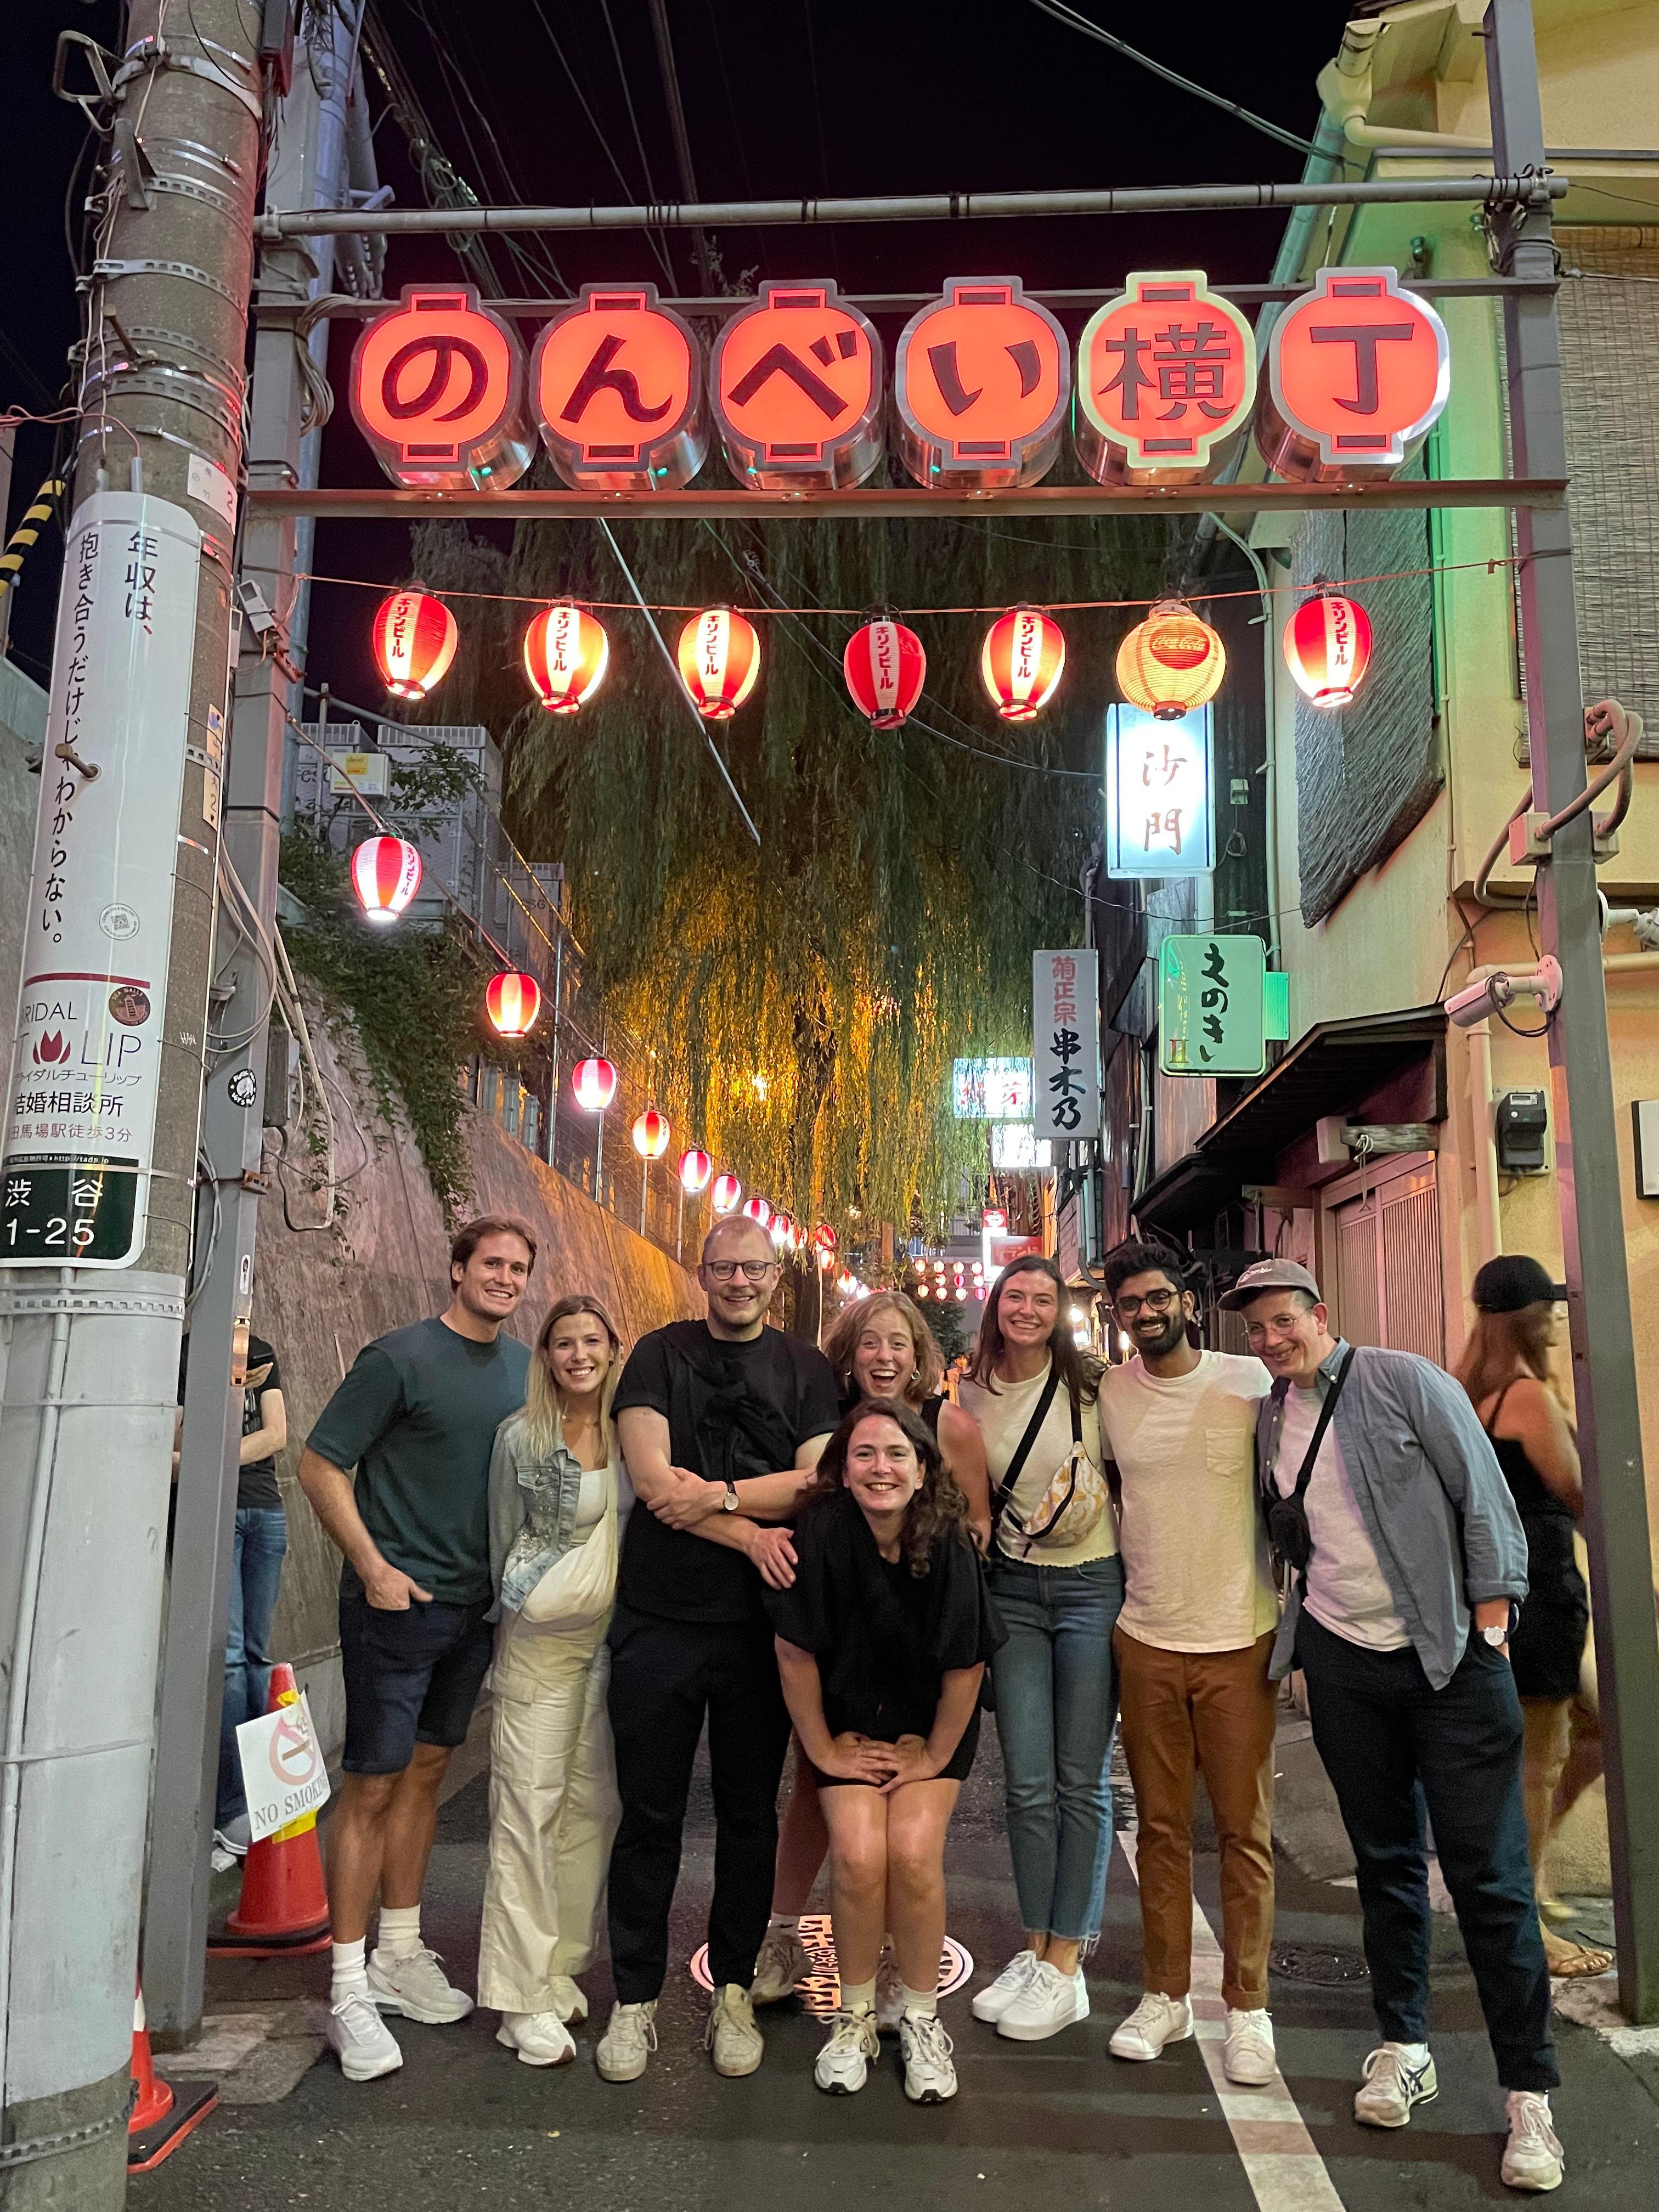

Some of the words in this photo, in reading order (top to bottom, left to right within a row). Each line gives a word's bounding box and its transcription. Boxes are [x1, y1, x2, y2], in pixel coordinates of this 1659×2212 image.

[382, 321, 1415, 424] のんべい横丁
[125, 531, 158, 635] 年収は、
[876, 627, 894, 690] キリンビール
[1017, 616, 1035, 678] キリンビール
[1330, 602, 1348, 665] キリンビール
[43, 532, 99, 943] 抱き合うだけじわからない。
[1142, 744, 1187, 855] 沙門
[21, 1001, 77, 1025] RIDAL
[1051, 956, 1077, 1026] 菊正宗
[15, 1069, 142, 1086] ライダルチューリップ
[1048, 1028, 1086, 1130] 串木乃
[9, 1123, 132, 1142] 田馬場駅徒歩3分
[54, 1154, 109, 1164] http//tadp.jp
[5, 1178, 104, 1207] 渋谷
[7, 1217, 94, 1246] 1-25
[254, 1803, 279, 1830] NO
